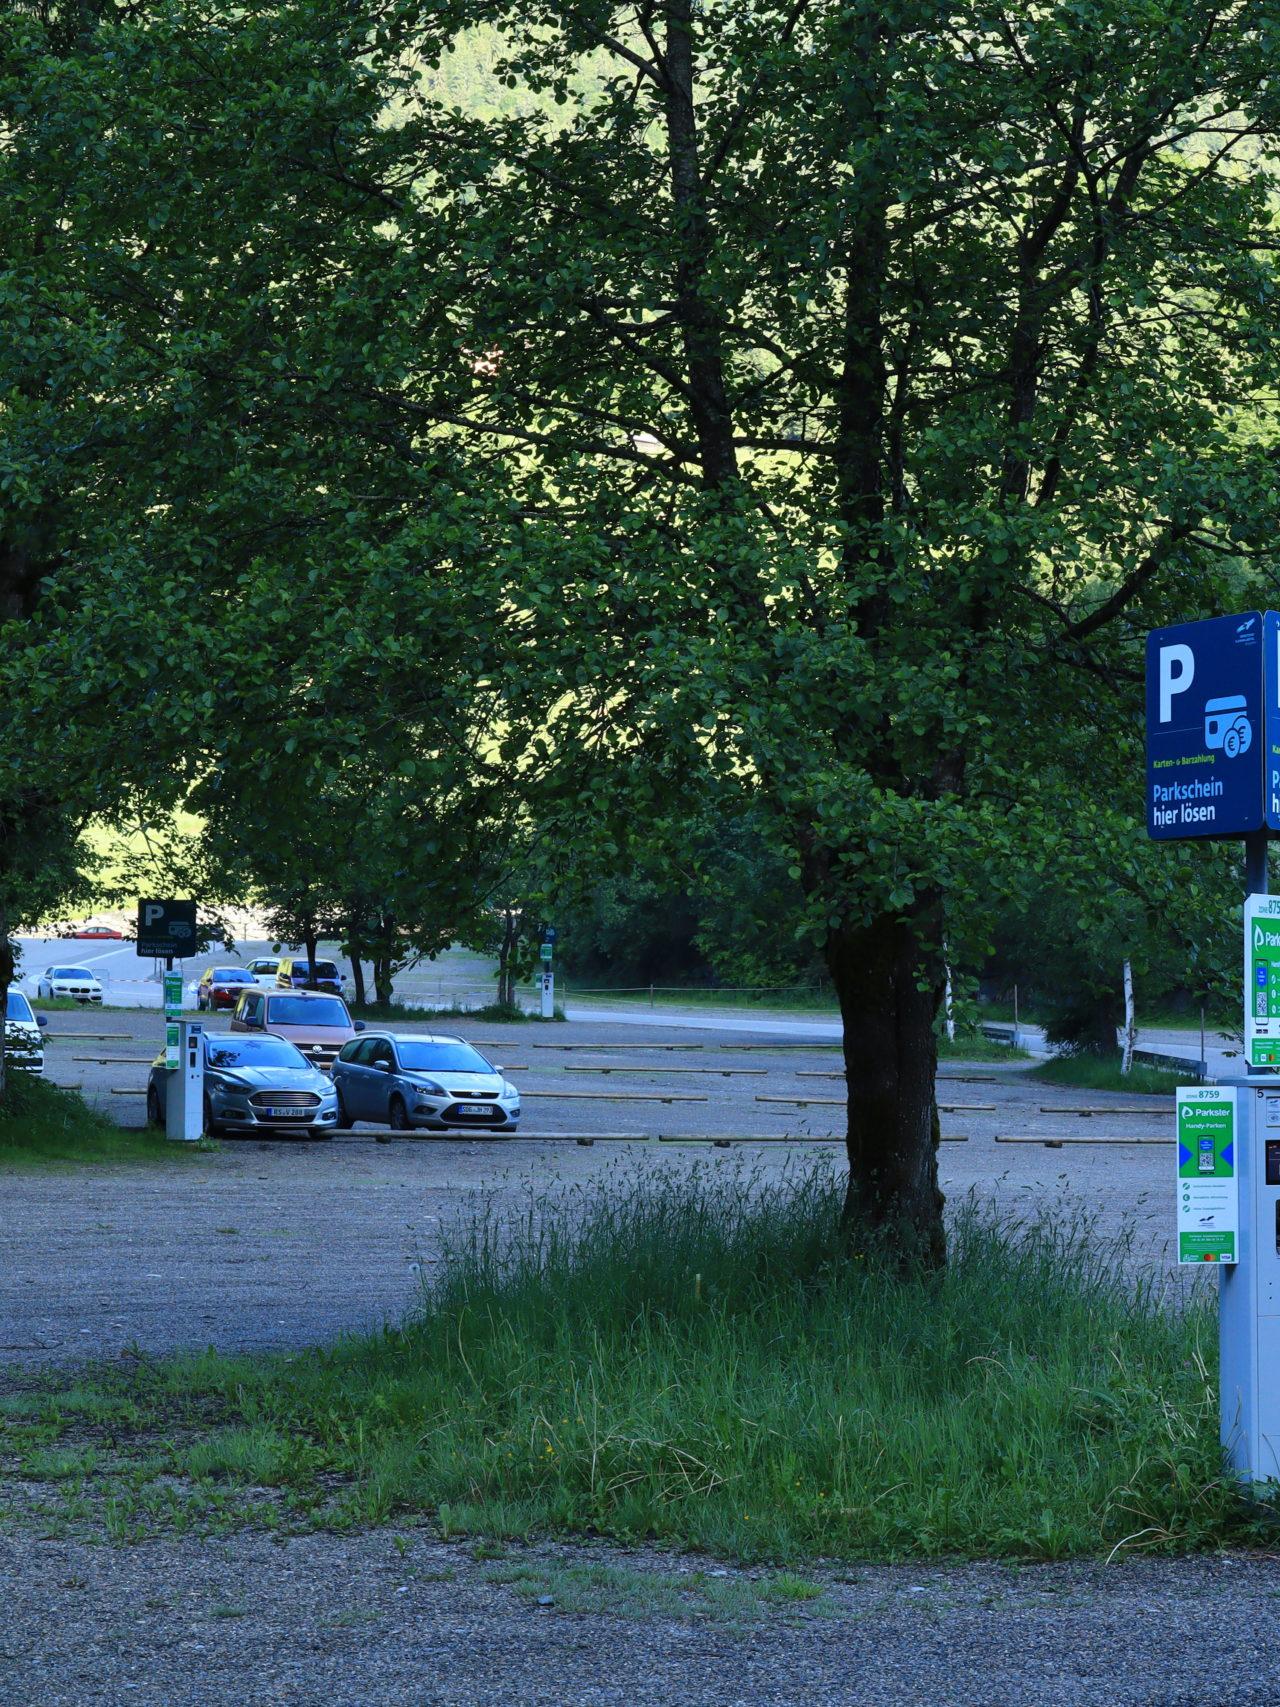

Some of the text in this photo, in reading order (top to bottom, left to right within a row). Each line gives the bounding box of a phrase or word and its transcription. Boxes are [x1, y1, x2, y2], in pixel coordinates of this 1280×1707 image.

[1159, 643, 1195, 724] P
[1153, 759, 1175, 769] Karten-
[1181, 753, 1216, 767] Barzahlung
[1153, 776, 1224, 803] Parkschein
[1153, 803, 1216, 826] hier lösen
[145, 904, 165, 927] P
[1198, 1090, 1220, 1099] 8759
[1256, 1088, 1264, 1098] 5
[1195, 1108, 1230, 1117] Parkster
